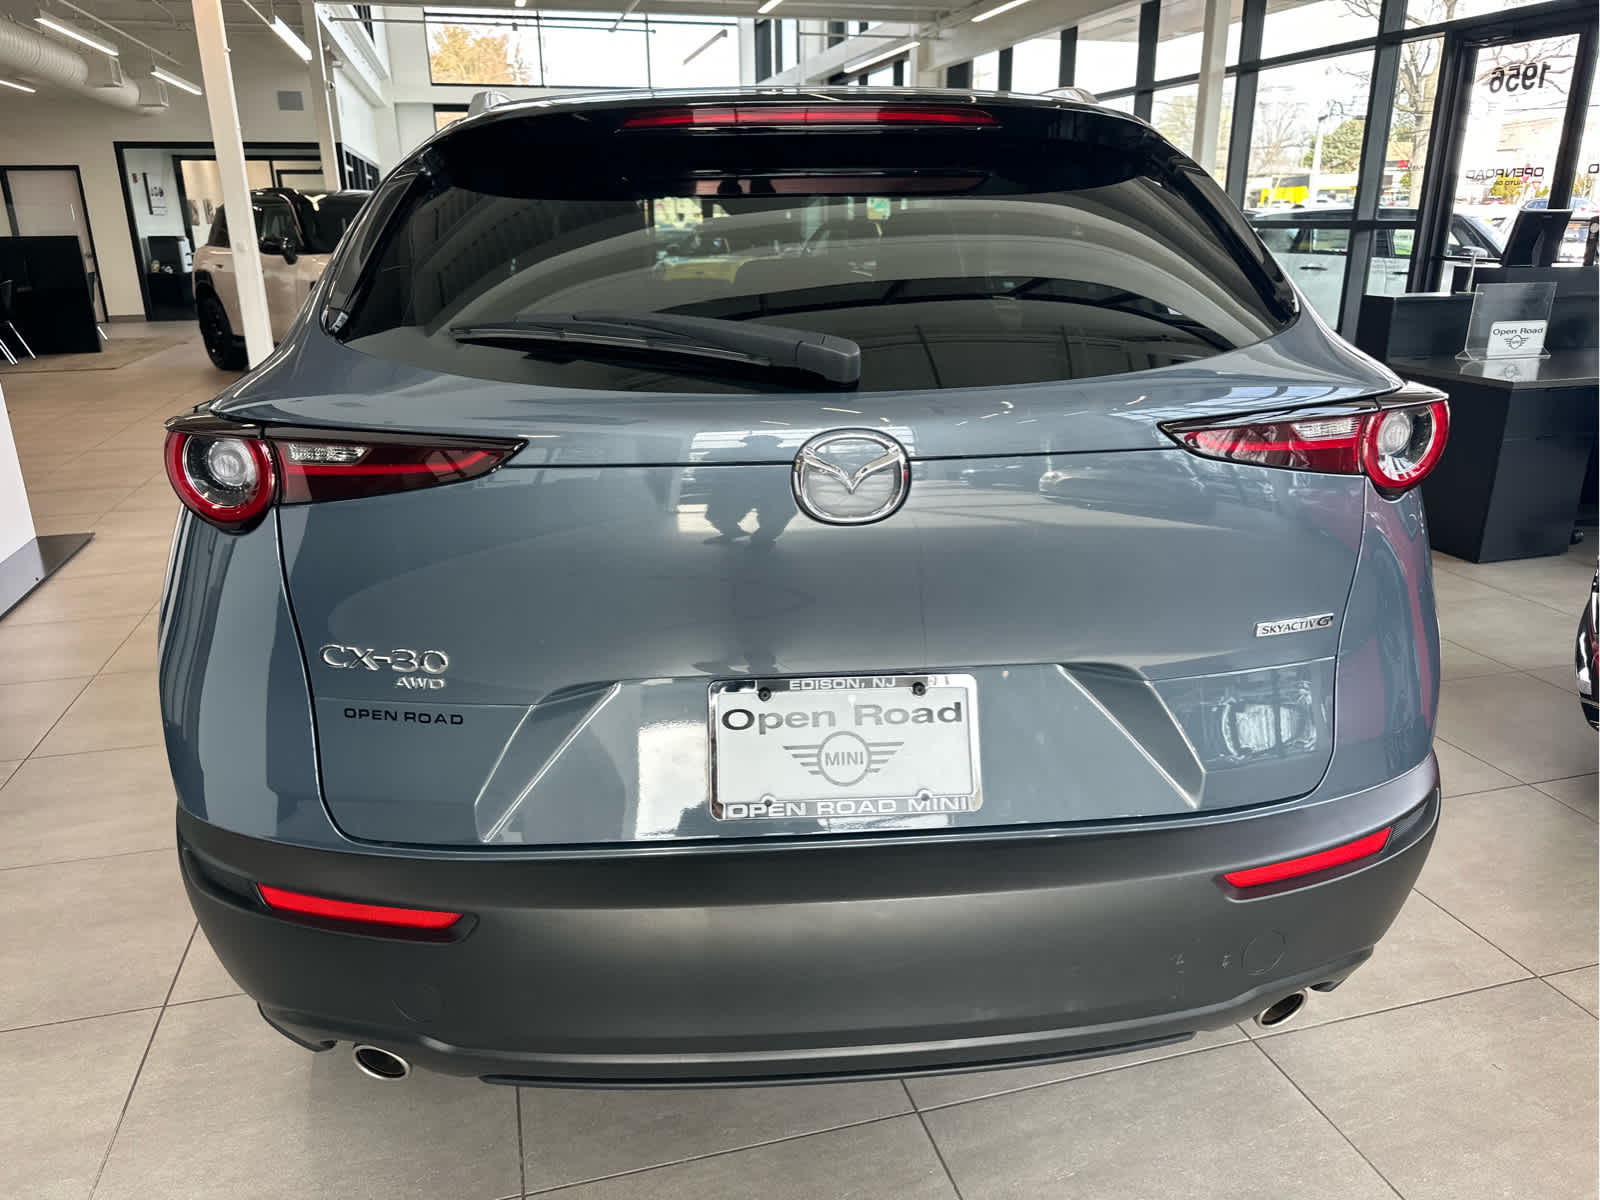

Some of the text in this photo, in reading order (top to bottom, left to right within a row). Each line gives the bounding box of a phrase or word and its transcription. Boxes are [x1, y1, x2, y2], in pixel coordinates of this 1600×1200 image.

[1493, 327, 1544, 336] Open Road
[320, 644, 449, 674] CX-30
[396, 676, 446, 689] AWD
[789, 677, 897, 691] EDISON, NJ
[344, 707, 464, 725] OPEN ROAD
[722, 702, 963, 735] Open Road
[824, 751, 865, 767] MINI
[727, 797, 968, 818] OPEN ROAD MINI
